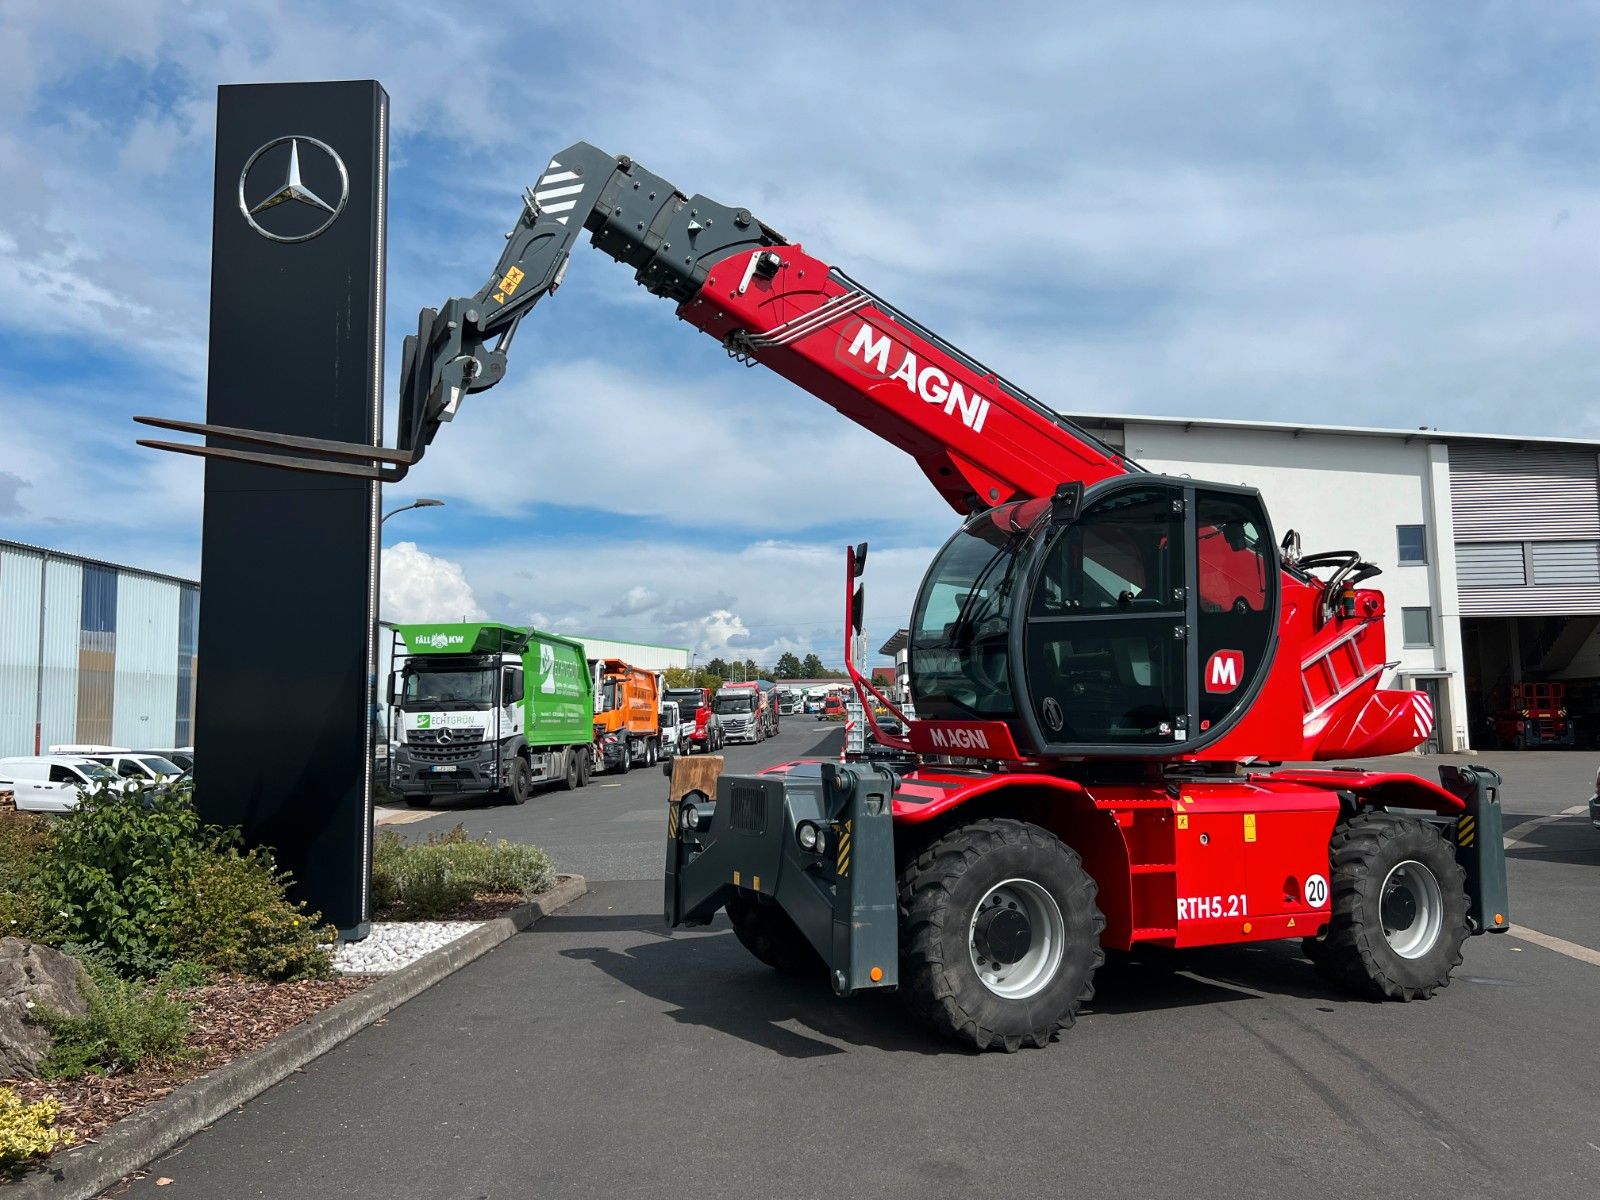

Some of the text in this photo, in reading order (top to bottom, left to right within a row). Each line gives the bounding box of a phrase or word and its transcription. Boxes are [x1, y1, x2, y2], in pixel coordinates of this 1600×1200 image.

[848, 324, 990, 433] MAGNI
[415, 634, 465, 645] FÄLL KW
[1211, 656, 1237, 686] M
[432, 715, 475, 725] ECHTGRÜN
[931, 728, 990, 750] MAGNI
[1307, 880, 1325, 902] 20
[1177, 894, 1248, 921] RTH5.21
